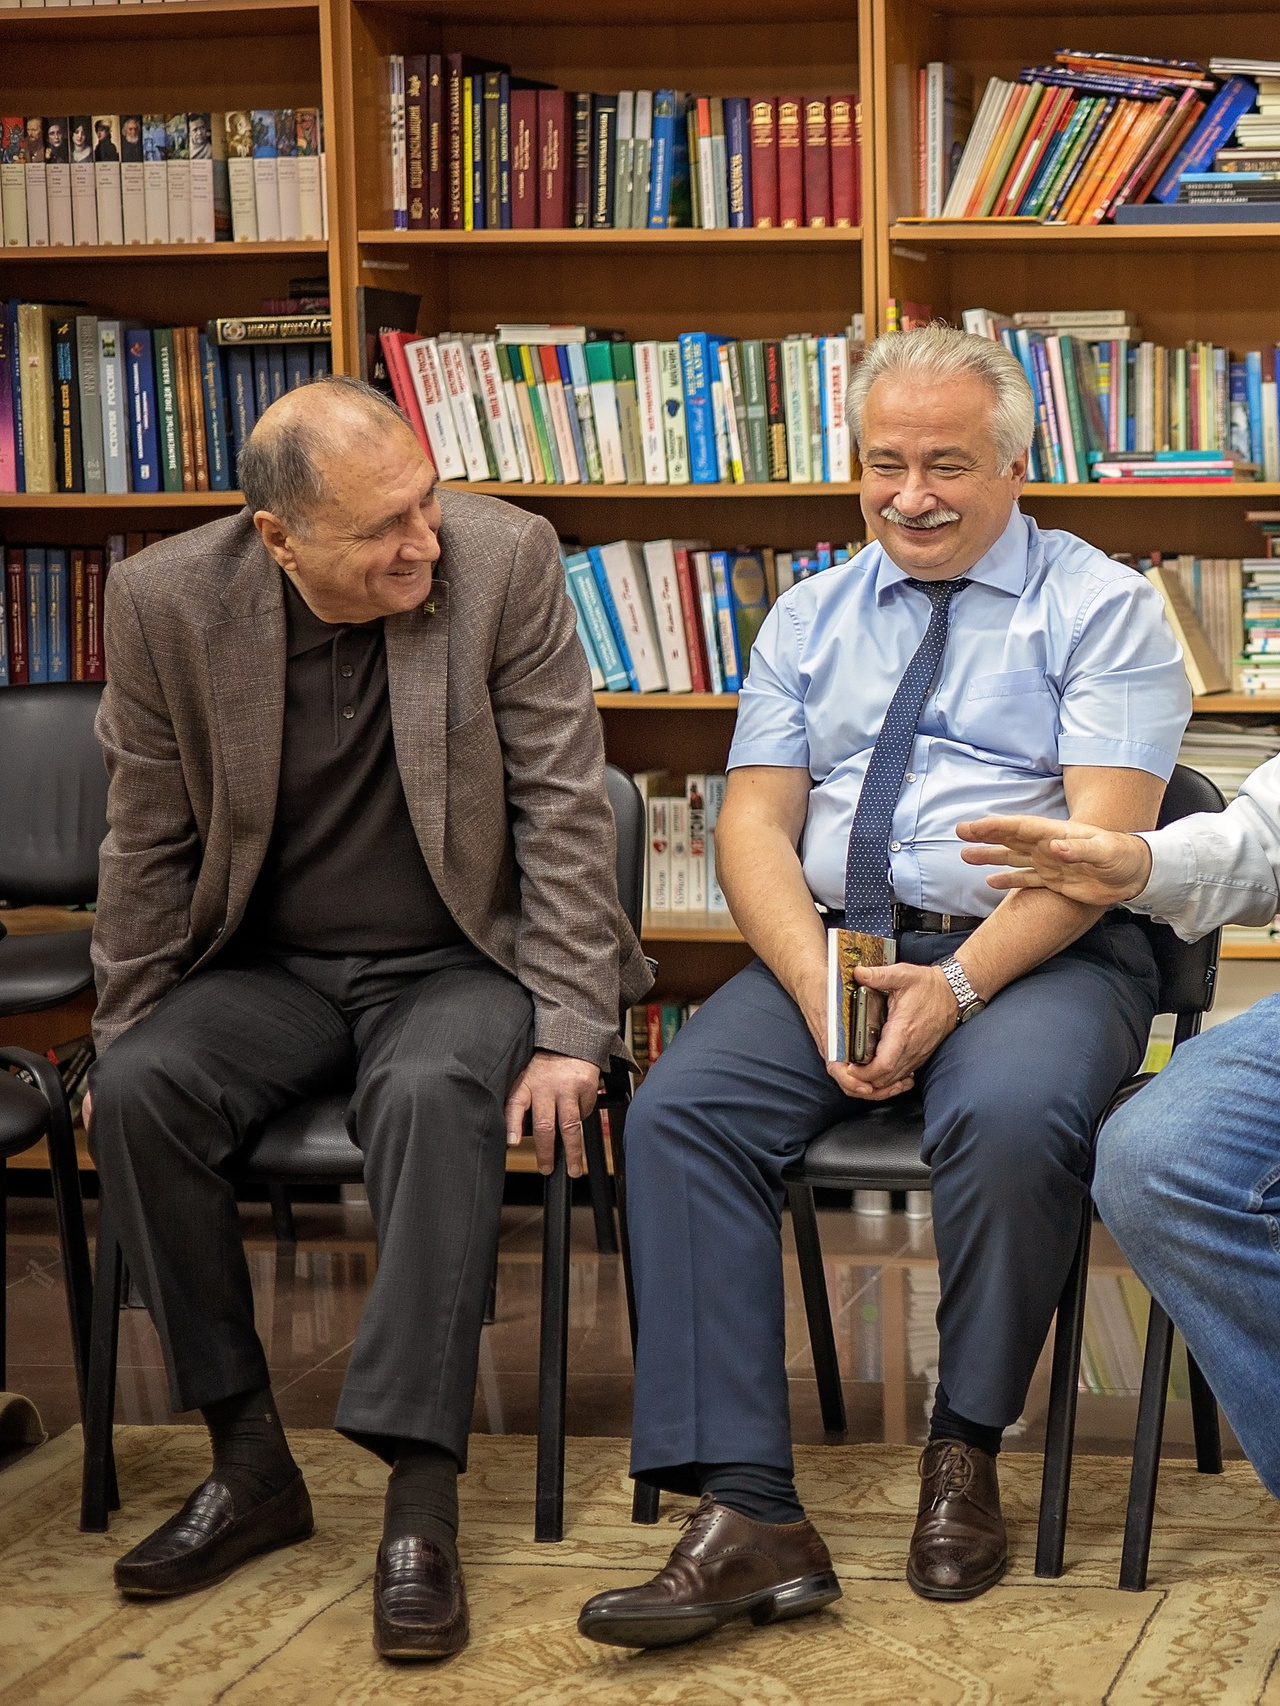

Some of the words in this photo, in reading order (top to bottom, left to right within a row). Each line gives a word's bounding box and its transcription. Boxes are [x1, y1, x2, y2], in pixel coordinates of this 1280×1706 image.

[450, 161, 461, 213] РУССКИЙ
[106, 363, 116, 405] РОССИИ
[161, 345, 171, 384] КАВКАЗА
[164, 386, 174, 412] ЛЮДИ
[108, 410, 119, 458] ИСТОРИЯ
[165, 414, 177, 470] ЗНАМЕНИТЫЕ
